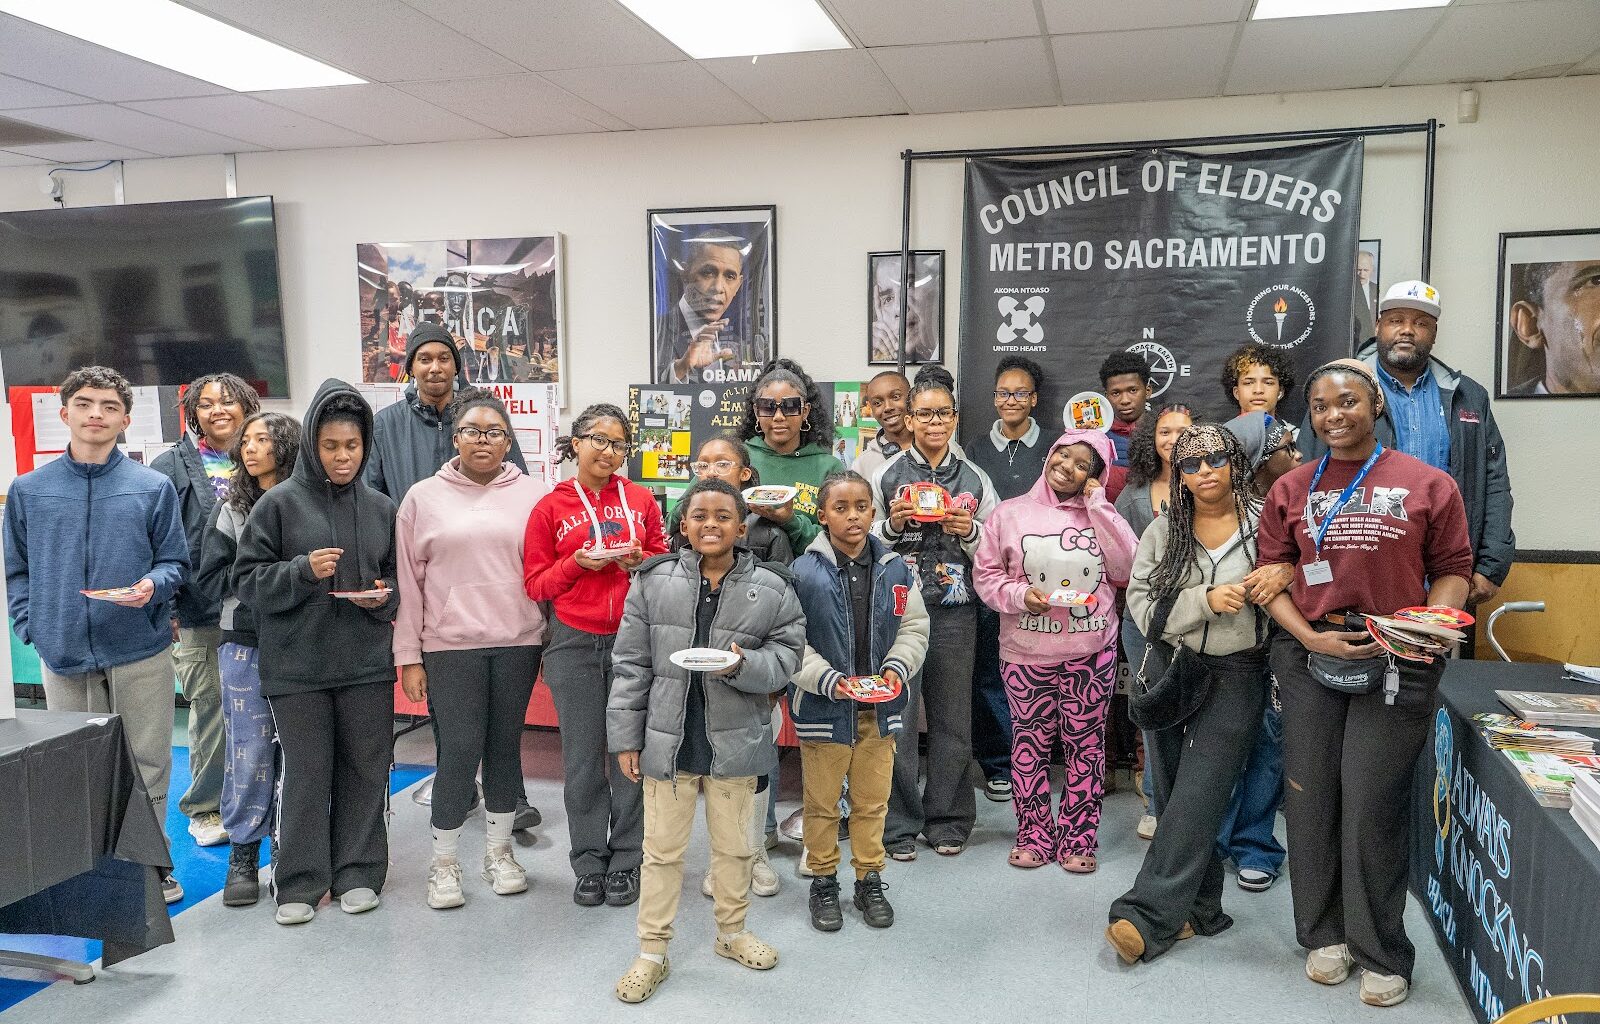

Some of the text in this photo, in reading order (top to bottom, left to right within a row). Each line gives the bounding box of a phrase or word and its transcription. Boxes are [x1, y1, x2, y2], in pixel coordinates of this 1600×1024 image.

[980, 160, 1342, 235] COUNCIL OF ELDERS
[989, 232, 1326, 272] METRO SACRAMENTO
[1246, 287, 1272, 322] HONORING
[1289, 285, 1316, 321] ANCESTORS
[1142, 327, 1155, 339] N
[1293, 326, 1313, 346] TORCH
[1130, 343, 1175, 370] SPACE EARTH
[702, 369, 761, 382] OBAMA
[1180, 365, 1191, 377] E
[1301, 486, 1410, 521] MLK
[1017, 615, 1063, 634] Hello
[1451, 751, 1511, 880] ALWAYS
